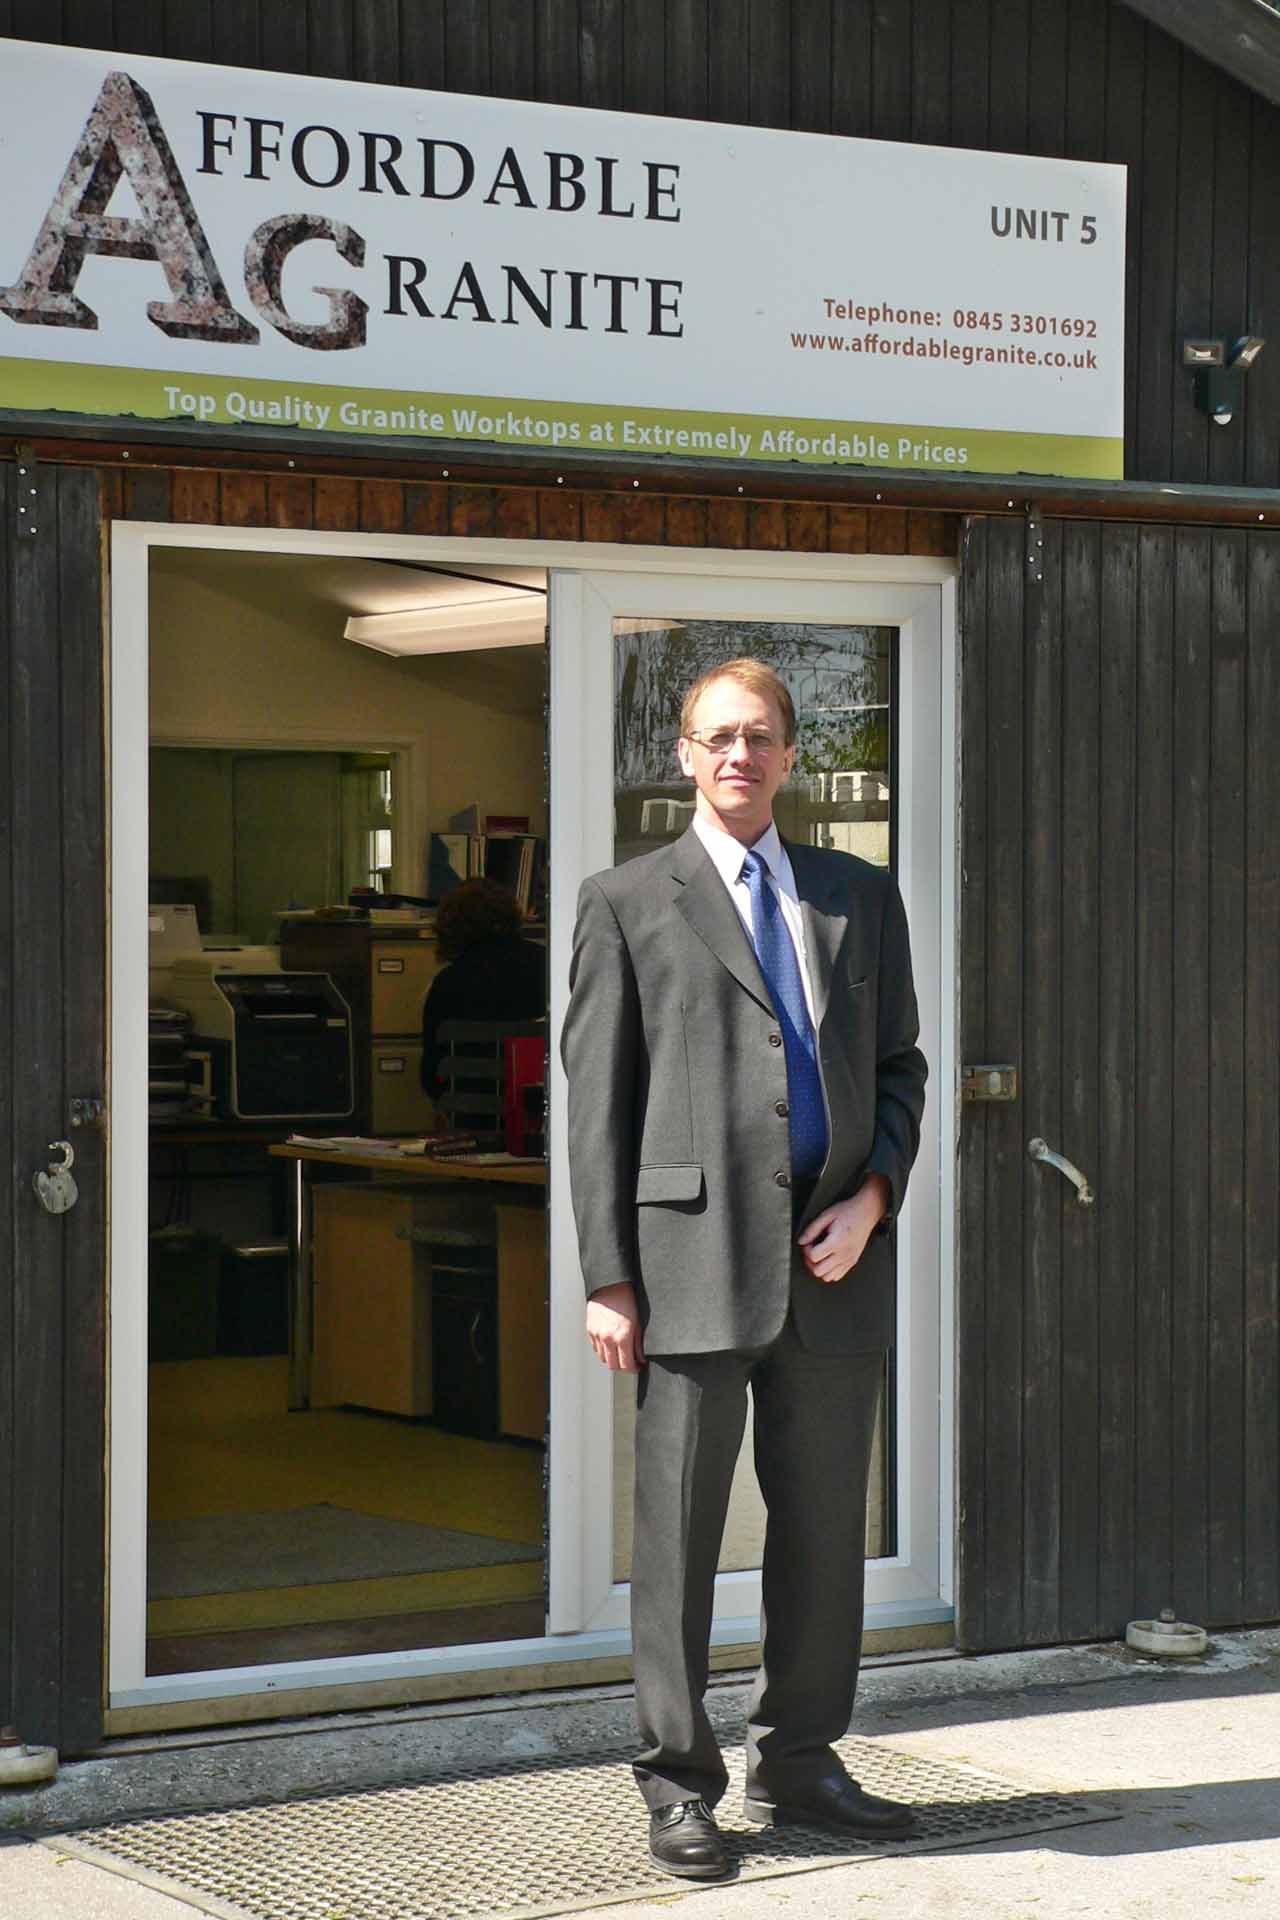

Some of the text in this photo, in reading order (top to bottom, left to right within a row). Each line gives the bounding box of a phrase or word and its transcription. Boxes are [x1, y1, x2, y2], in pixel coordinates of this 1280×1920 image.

[0, 72, 682, 345] AFFORDABLE
[990, 206, 1097, 244] UNIT 5
[244, 213, 684, 352] GRANITE
[823, 298, 1097, 338] Telephone: 0845 3301692
[791, 331, 1097, 369] www.affordablegranite.co.uk
[163, 386, 968, 464] Top Quality Granite Worktops at Extremely Affordable Prices
